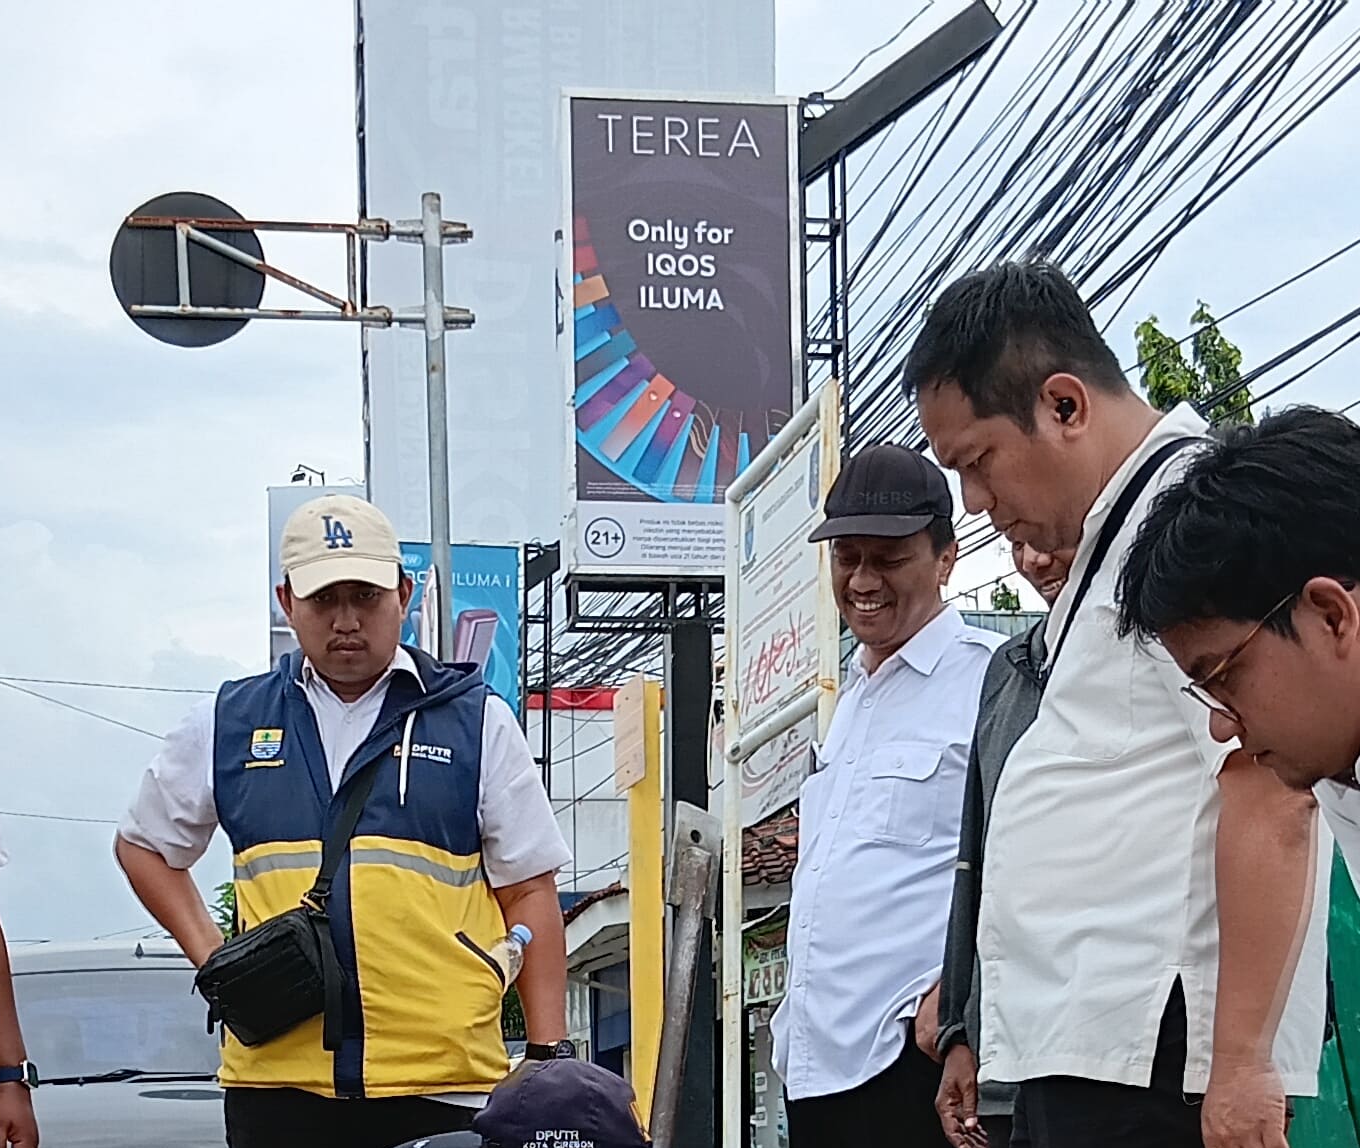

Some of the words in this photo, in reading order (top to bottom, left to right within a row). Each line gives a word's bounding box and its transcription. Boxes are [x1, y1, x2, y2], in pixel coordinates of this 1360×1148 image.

[597, 113, 761, 158] TEREA
[628, 218, 688, 250] Only
[694, 220, 734, 244] for
[647, 252, 716, 277] IQOS
[639, 285, 724, 310] ILUMA
[321, 514, 354, 549] LA
[590, 530, 622, 546] 21+
[535, 1129, 580, 1141] DPUTR
